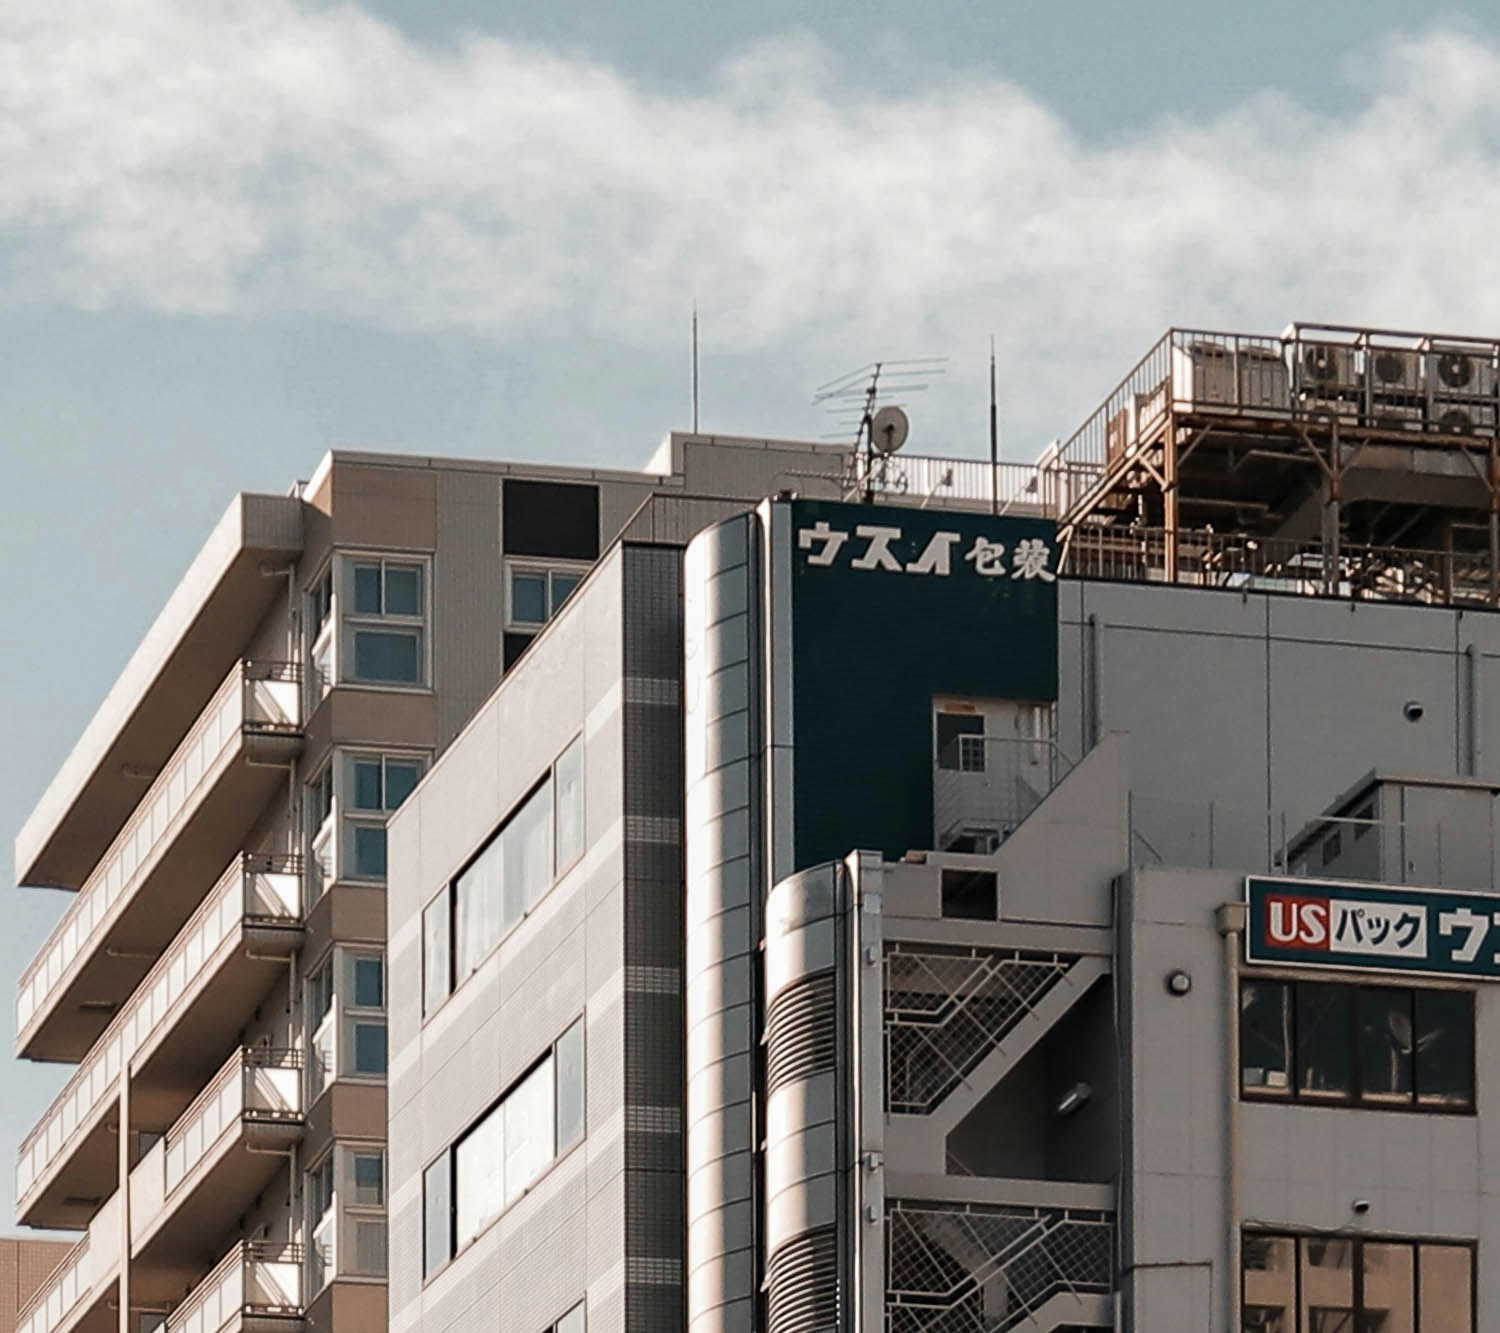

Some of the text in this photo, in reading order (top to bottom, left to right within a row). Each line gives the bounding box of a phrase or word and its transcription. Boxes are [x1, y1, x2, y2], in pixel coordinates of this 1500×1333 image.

[799, 522, 1055, 581] ウスイ包装
[1269, 901, 1328, 944] US
[1336, 908, 1421, 947] パック
